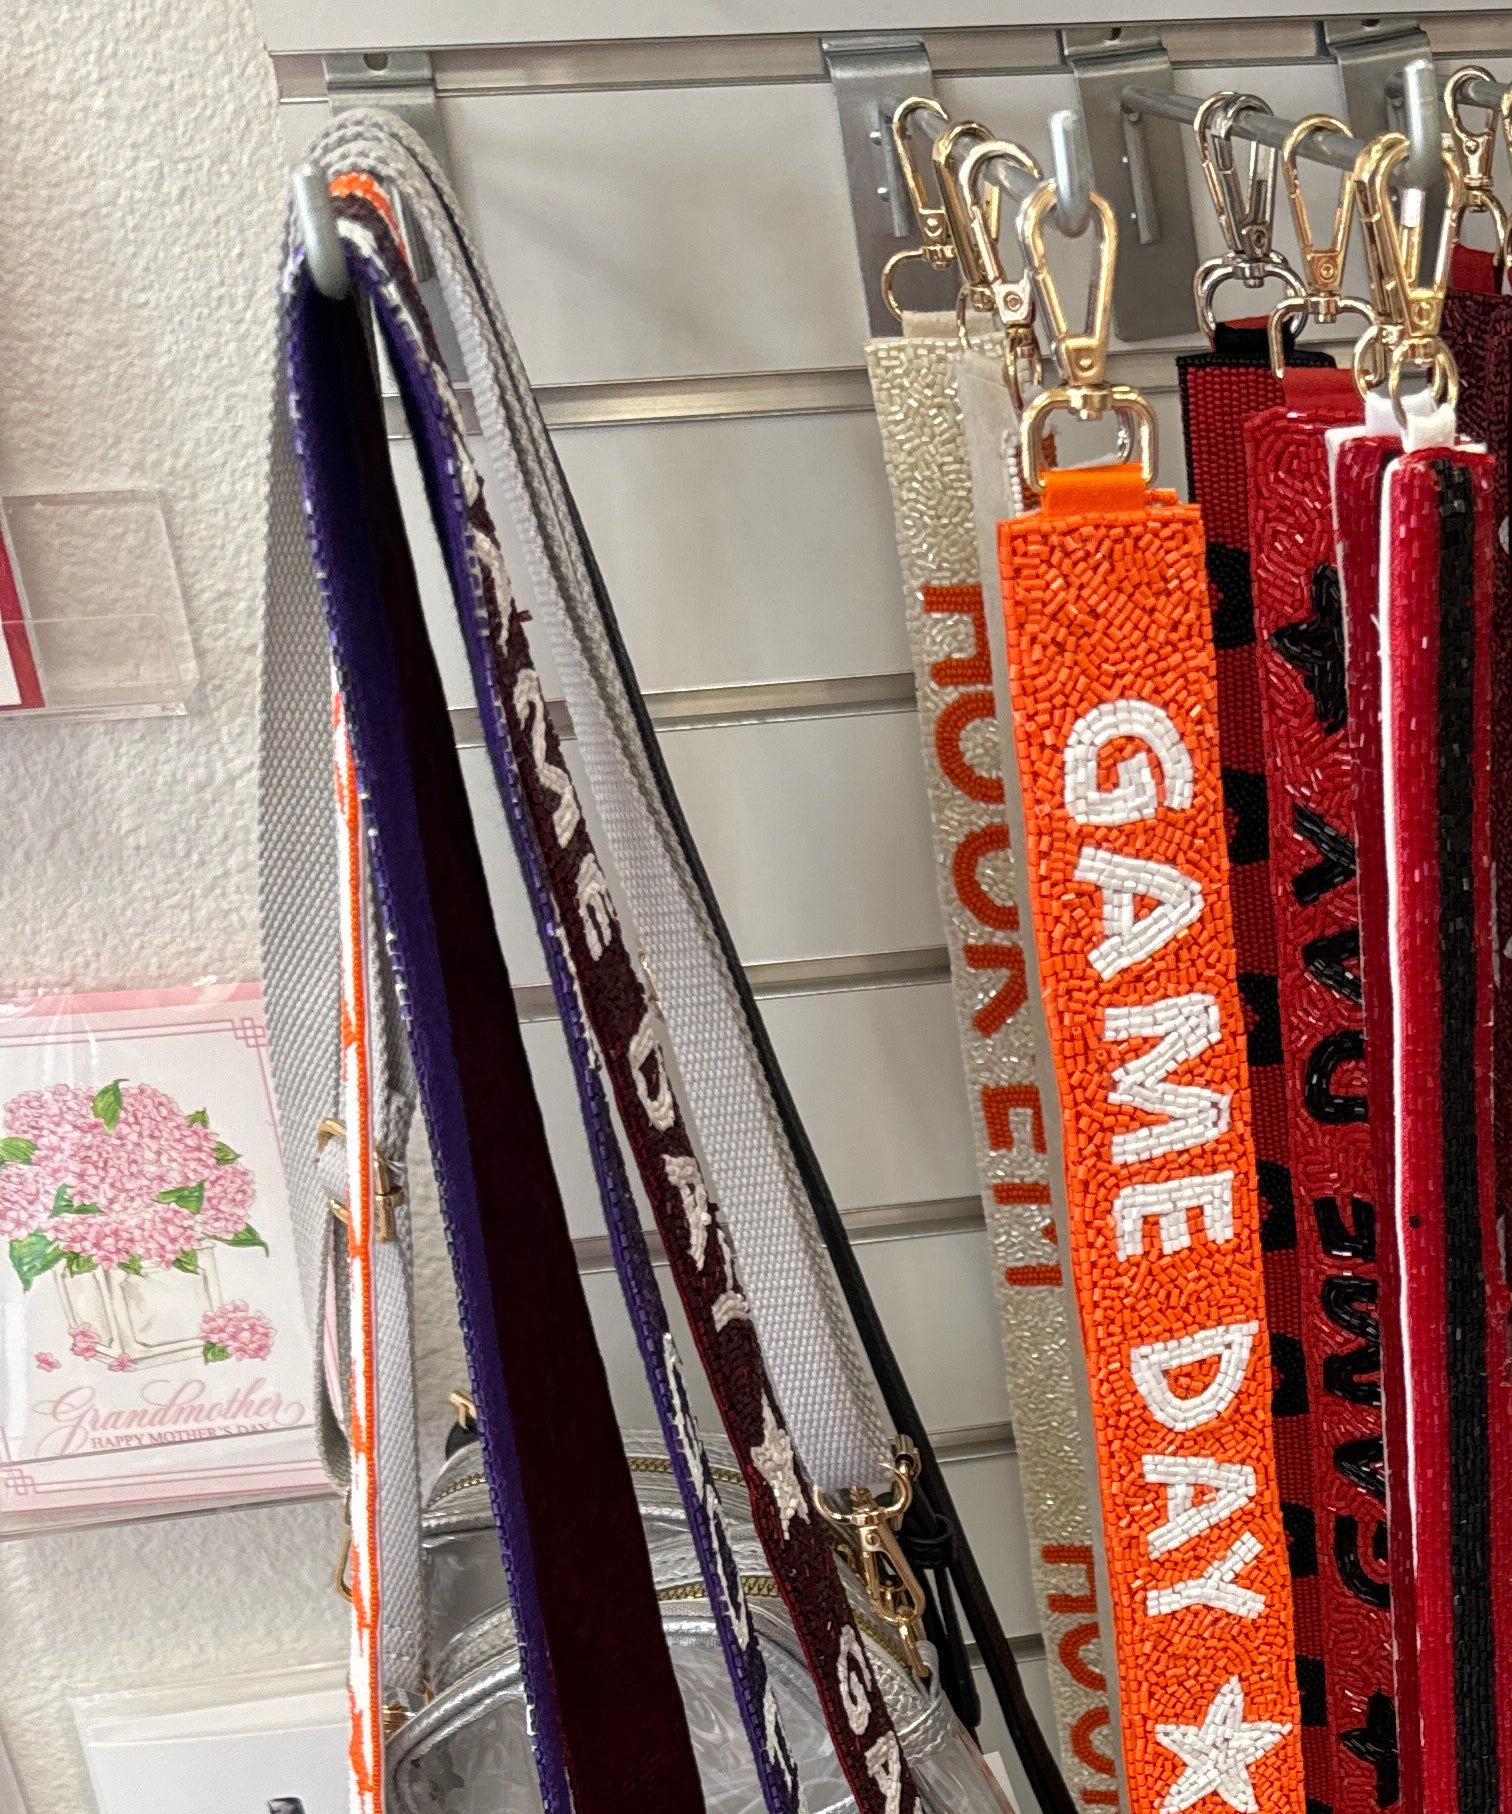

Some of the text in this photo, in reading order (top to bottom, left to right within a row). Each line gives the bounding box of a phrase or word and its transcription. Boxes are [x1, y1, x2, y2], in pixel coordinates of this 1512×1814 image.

[1064, 699, 1267, 1619] GAME DAY
[32, 1377, 306, 1457] Grandmother
[90, 1422, 271, 1450] HAPPY MOTHER'S DAY
